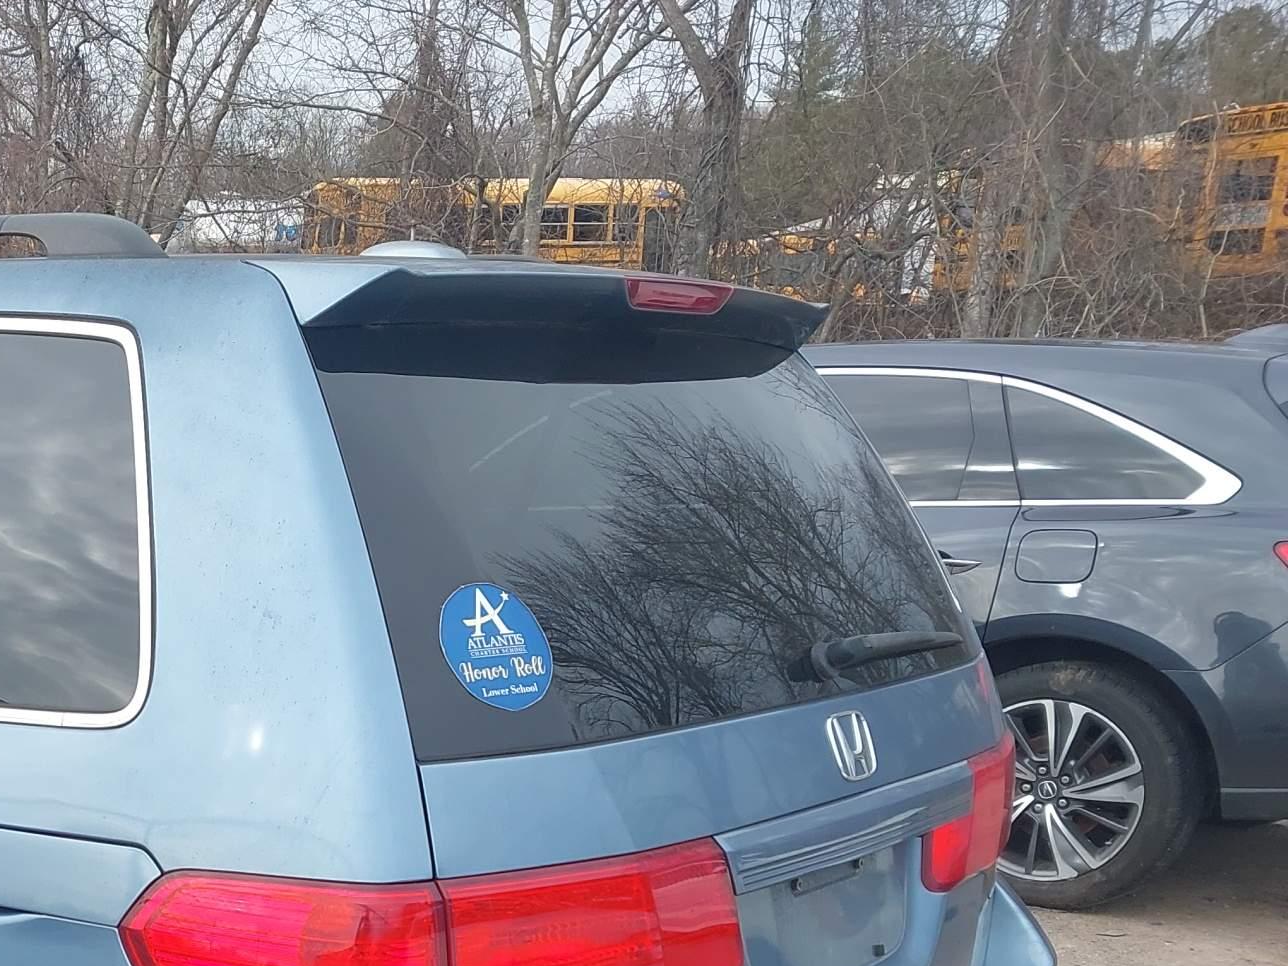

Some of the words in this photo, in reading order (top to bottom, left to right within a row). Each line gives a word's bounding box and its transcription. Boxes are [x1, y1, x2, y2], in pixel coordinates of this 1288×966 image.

[468, 634, 525, 649] ATLANTIS
[459, 661, 509, 682] Honor
[511, 656, 546, 677] Roll
[482, 687, 510, 698] Lower
[511, 683, 538, 695] School
